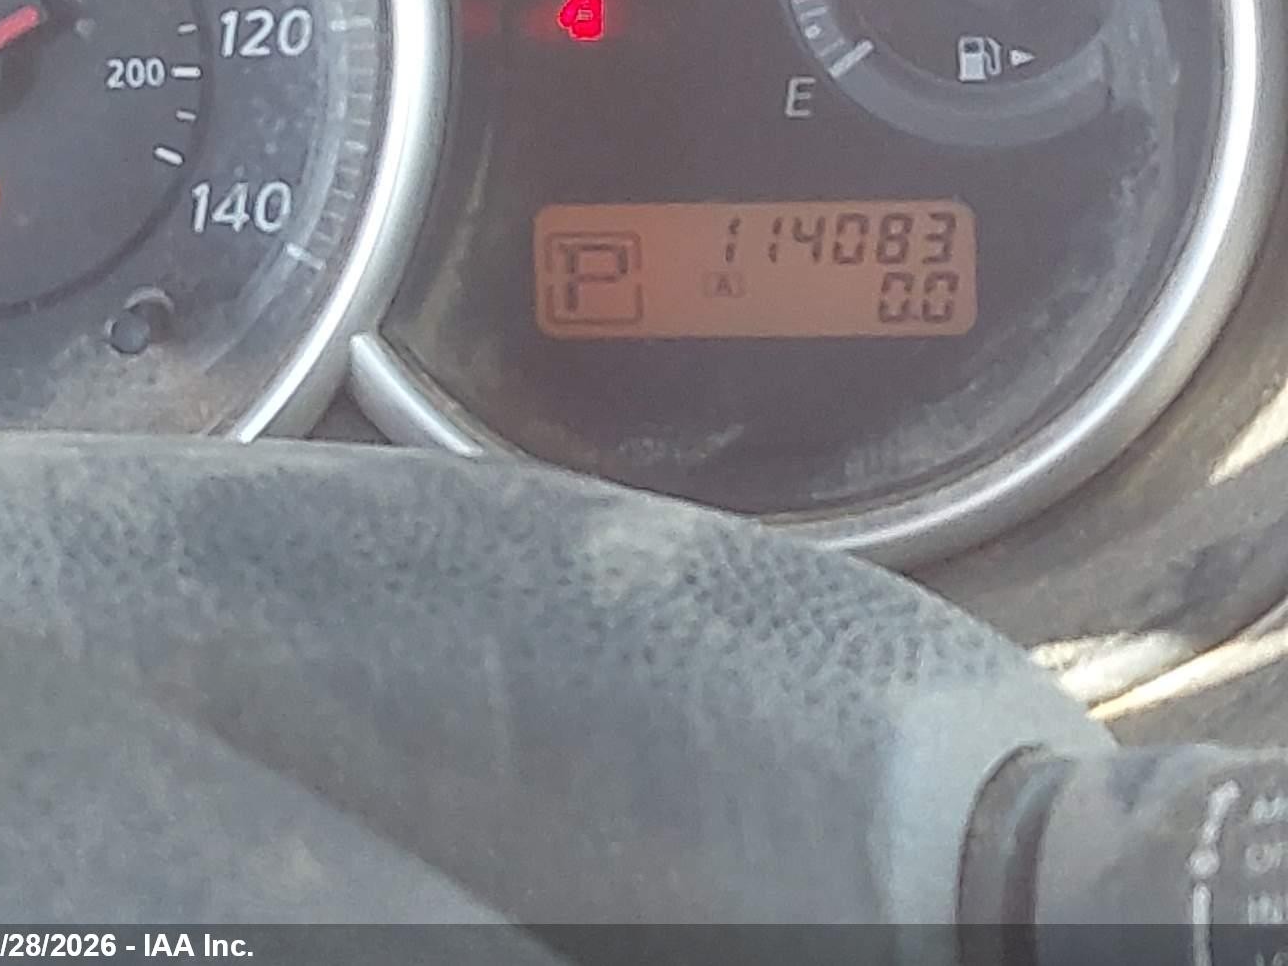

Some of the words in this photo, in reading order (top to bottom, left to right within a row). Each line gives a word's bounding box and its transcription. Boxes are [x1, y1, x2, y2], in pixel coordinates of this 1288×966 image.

[219, 8, 312, 58] 120
[106, 58, 166, 88] 200
[784, 78, 815, 118] E
[191, 181, 293, 233] 140
[724, 212, 957, 266] 114083
[557, 243, 629, 312] P
